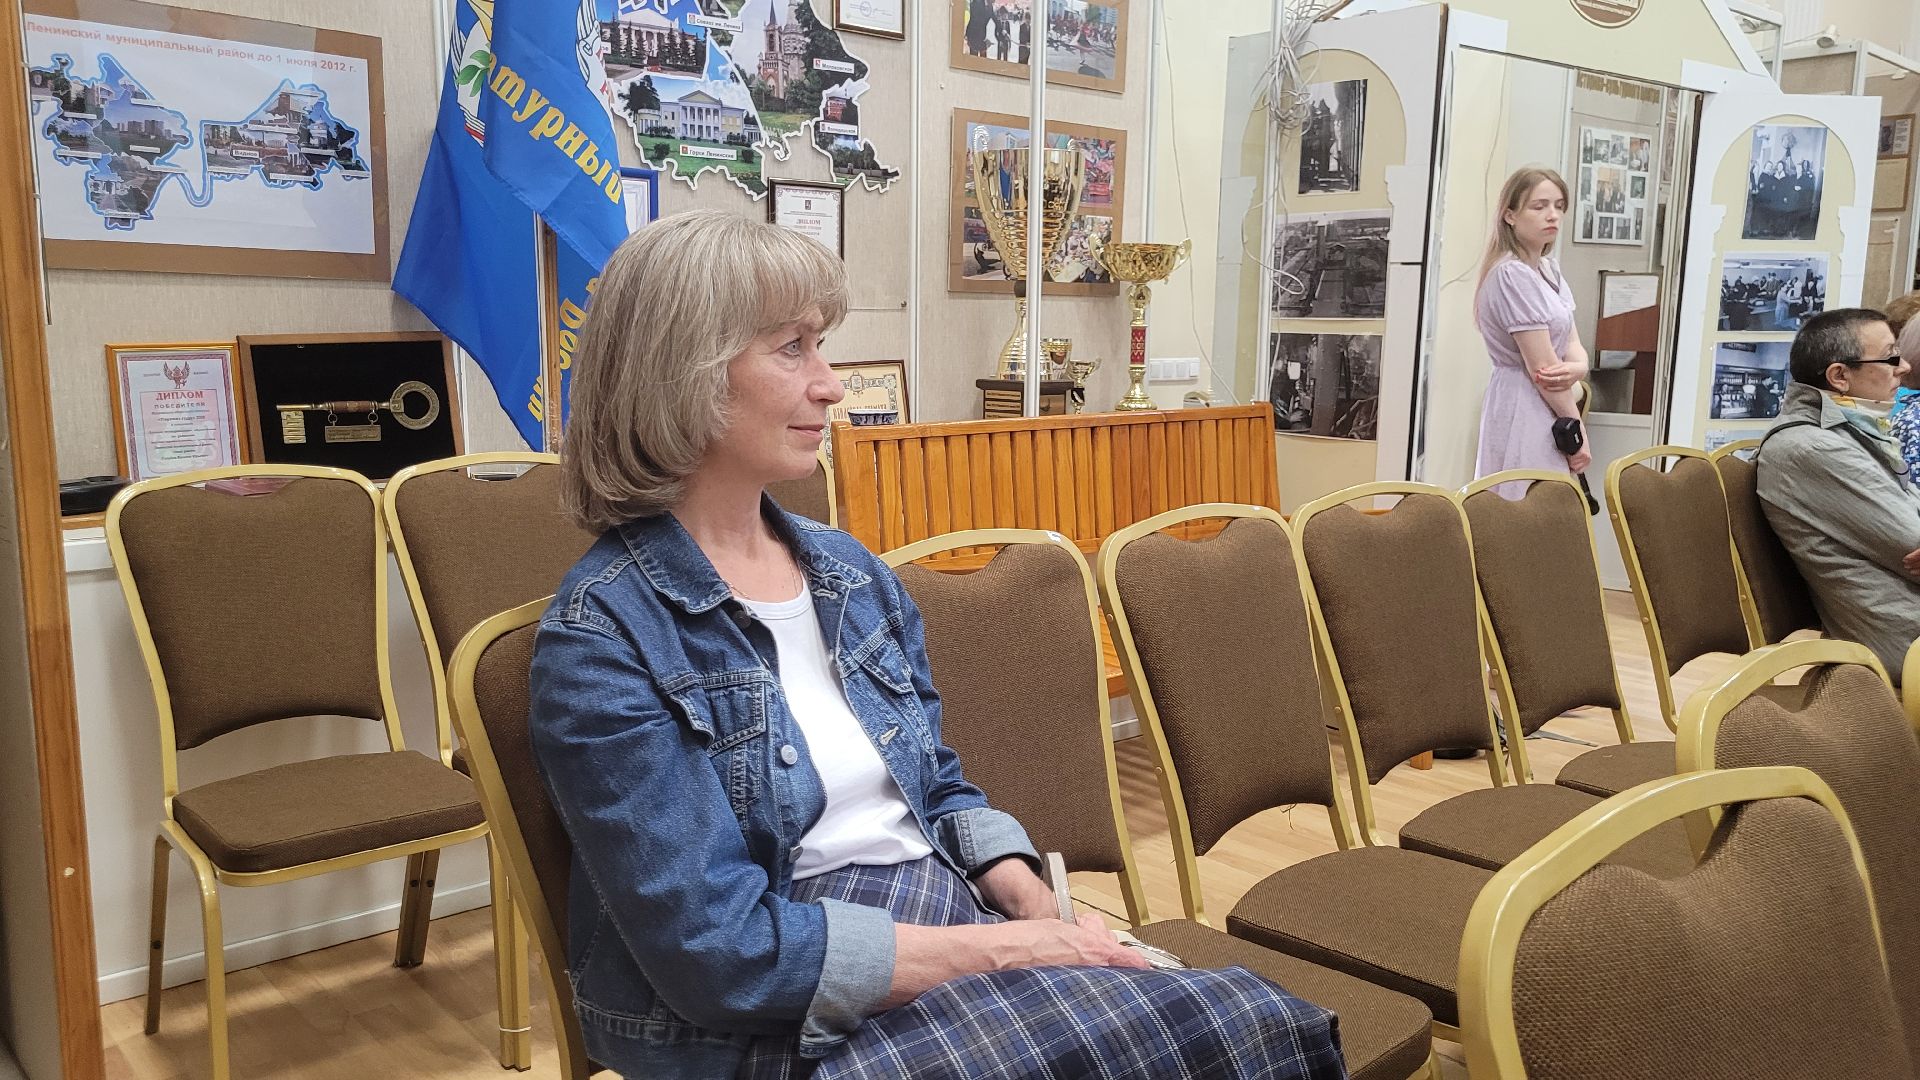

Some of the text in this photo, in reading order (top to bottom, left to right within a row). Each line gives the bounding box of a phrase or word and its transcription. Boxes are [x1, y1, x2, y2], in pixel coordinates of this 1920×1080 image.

[26, 21, 101, 40] Ленинский
[106, 33, 213, 54] муниципальный
[217, 47, 254, 60] район
[257, 54, 272, 62] до
[276, 54, 282, 63] 1
[286, 58, 318, 68] июля
[320, 59, 346, 72] 2012
[156, 390, 204, 401] ДИПЛОМ
